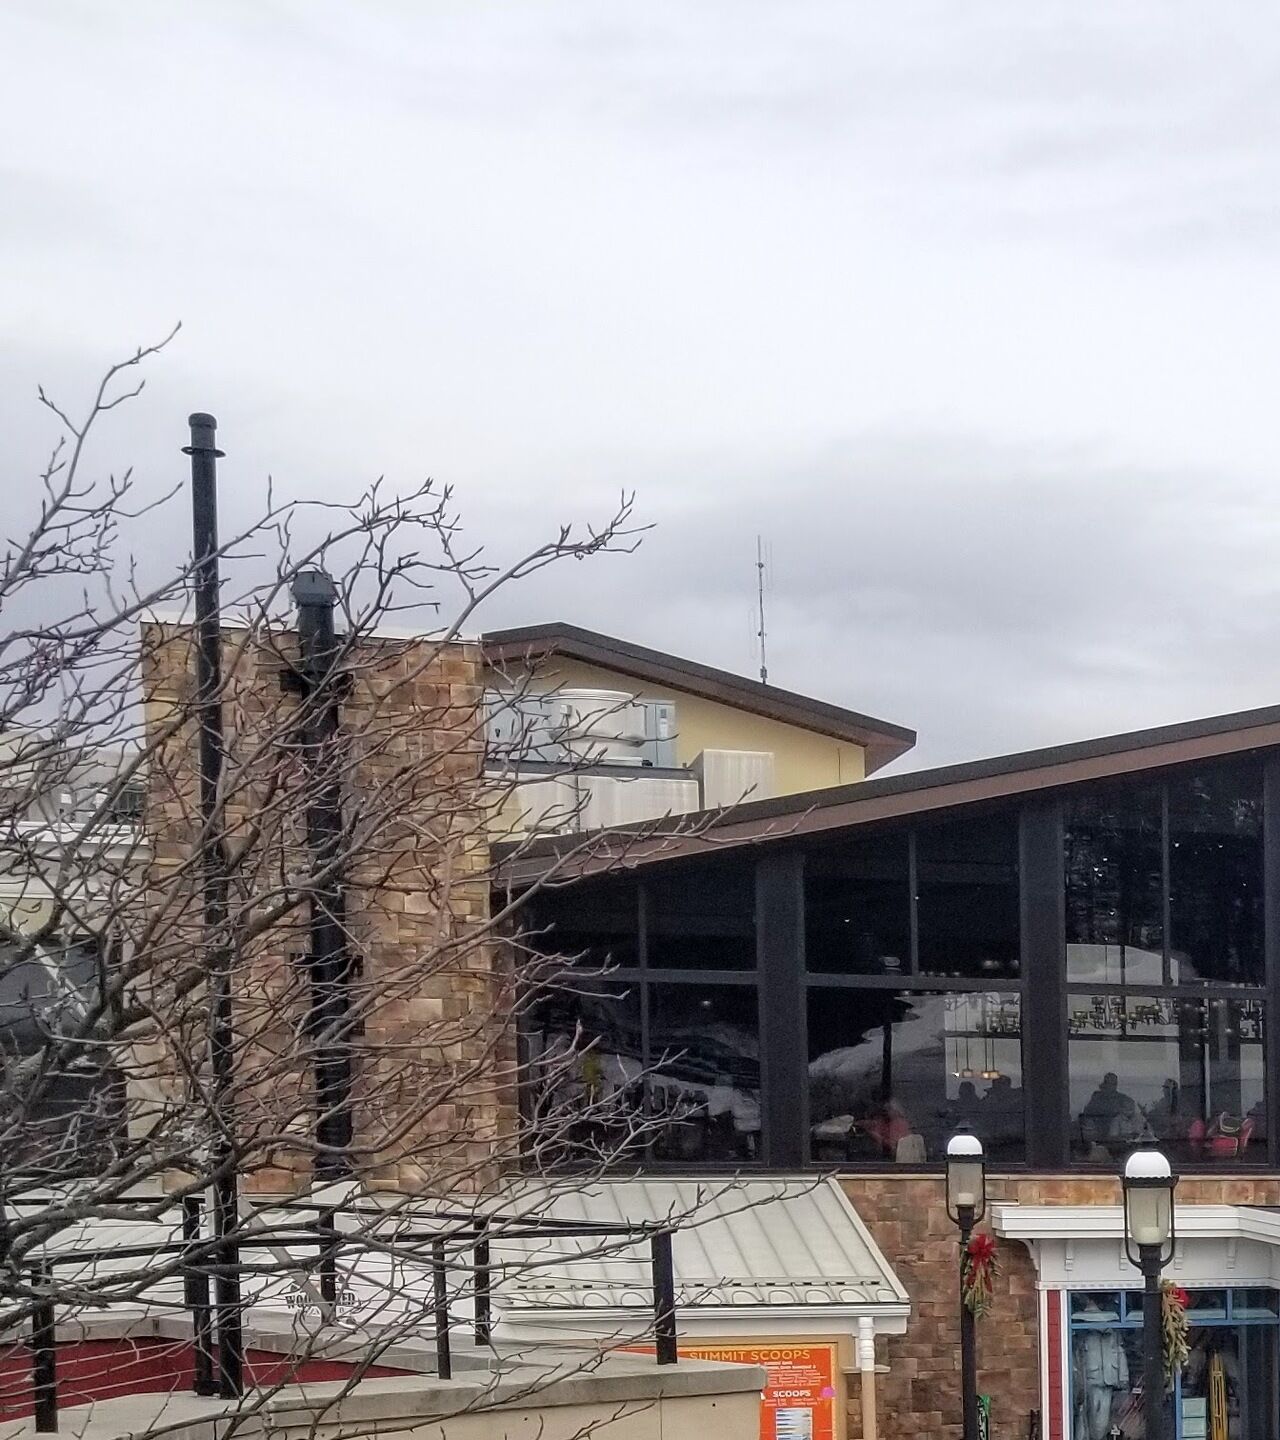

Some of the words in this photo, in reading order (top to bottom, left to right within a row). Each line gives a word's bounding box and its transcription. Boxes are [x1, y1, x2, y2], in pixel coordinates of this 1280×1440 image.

[689, 1351, 746, 1361] SUMMIT
[751, 1350, 810, 1360] SCOOPS
[772, 1390, 811, 1398] SCOOPS
